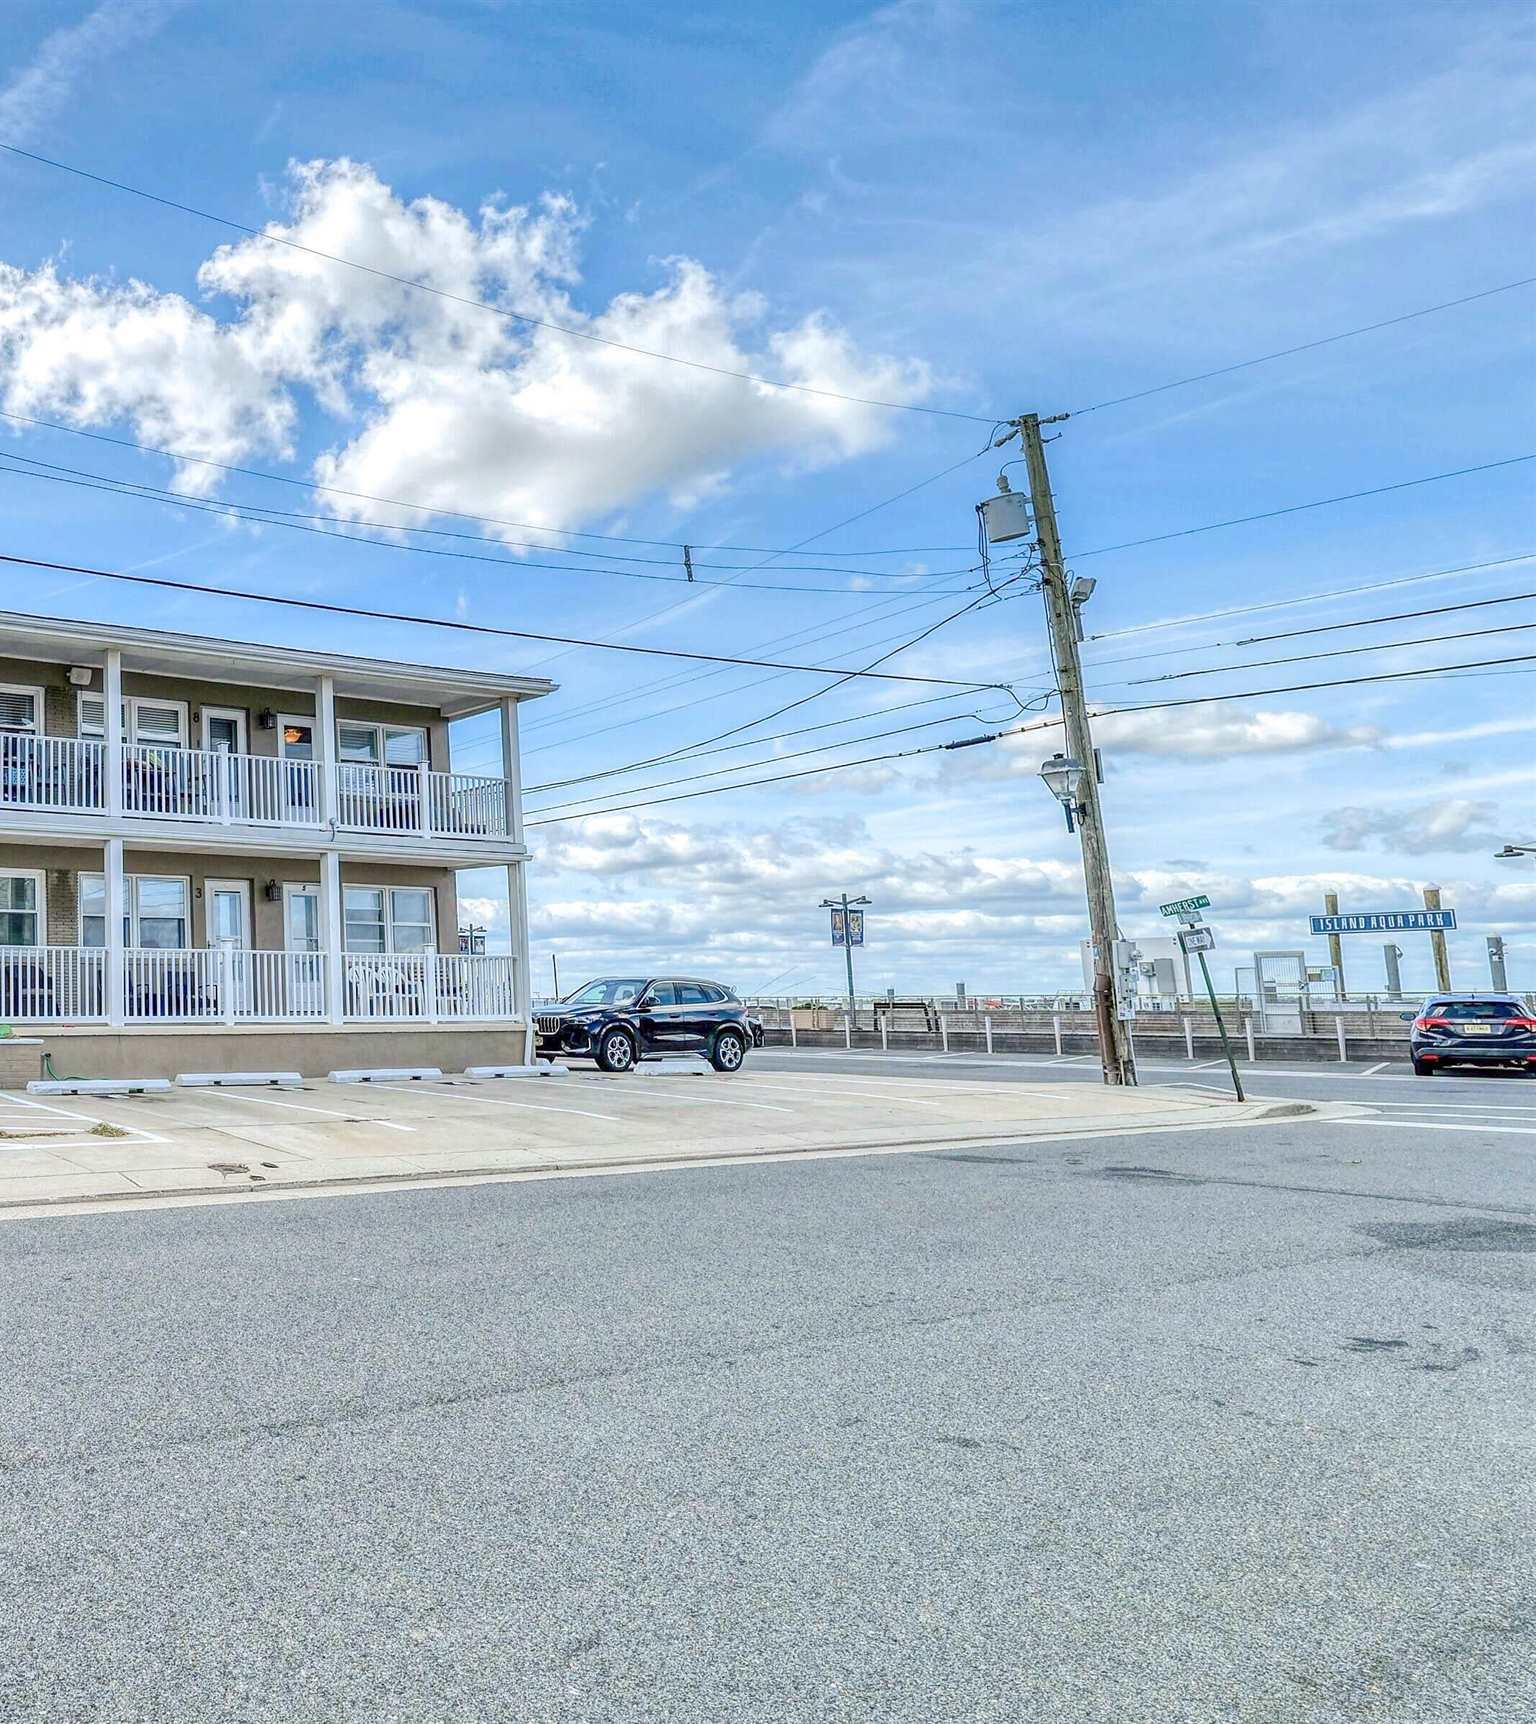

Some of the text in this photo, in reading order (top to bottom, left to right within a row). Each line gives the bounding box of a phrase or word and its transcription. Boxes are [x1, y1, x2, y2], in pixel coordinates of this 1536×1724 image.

[193, 712, 200, 723] 8
[195, 887, 202, 899] 3
[1161, 899, 1199, 915] AMHERST
[1320, 913, 1444, 931] ISLAND AQUA PARK
